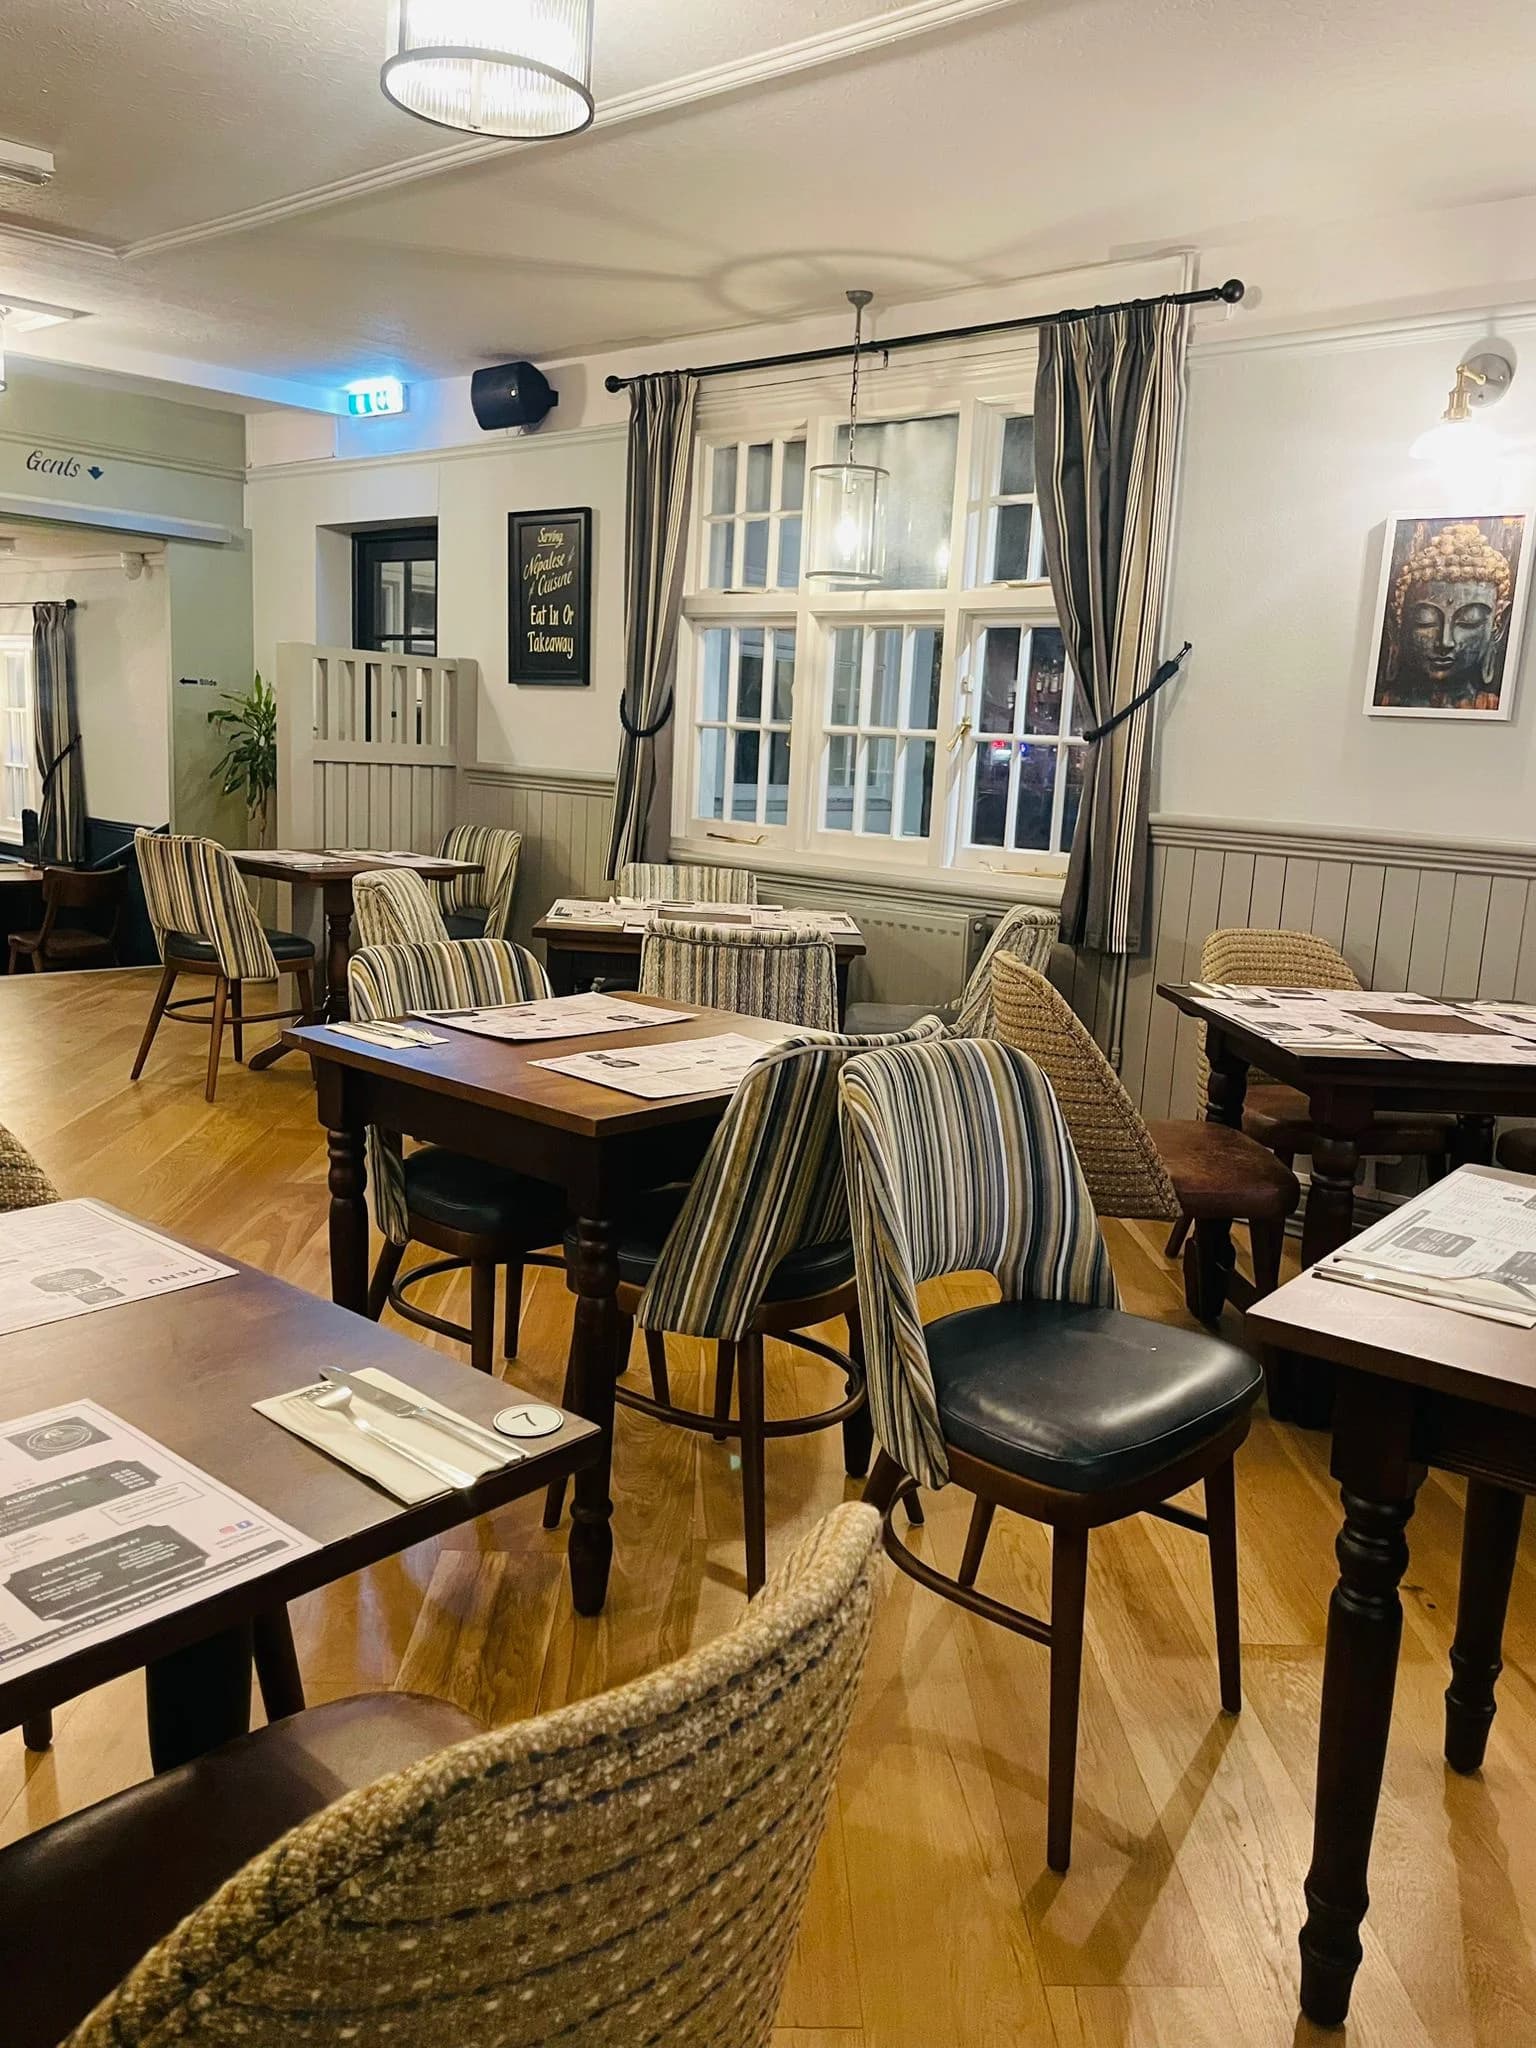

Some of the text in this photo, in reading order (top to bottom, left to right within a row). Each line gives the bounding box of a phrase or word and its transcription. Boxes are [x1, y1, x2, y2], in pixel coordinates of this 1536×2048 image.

[537, 527, 564, 548] Serving
[523, 551, 566, 580] Nepalese
[538, 570, 573, 596] Cuisine
[531, 604, 574, 625] Eat In Or
[527, 631, 574, 660] Takeaway
[148, 1267, 208, 1284] MENU
[512, 1412, 536, 1427] 7
[6, 1486, 61, 1505] ALCOHOL
